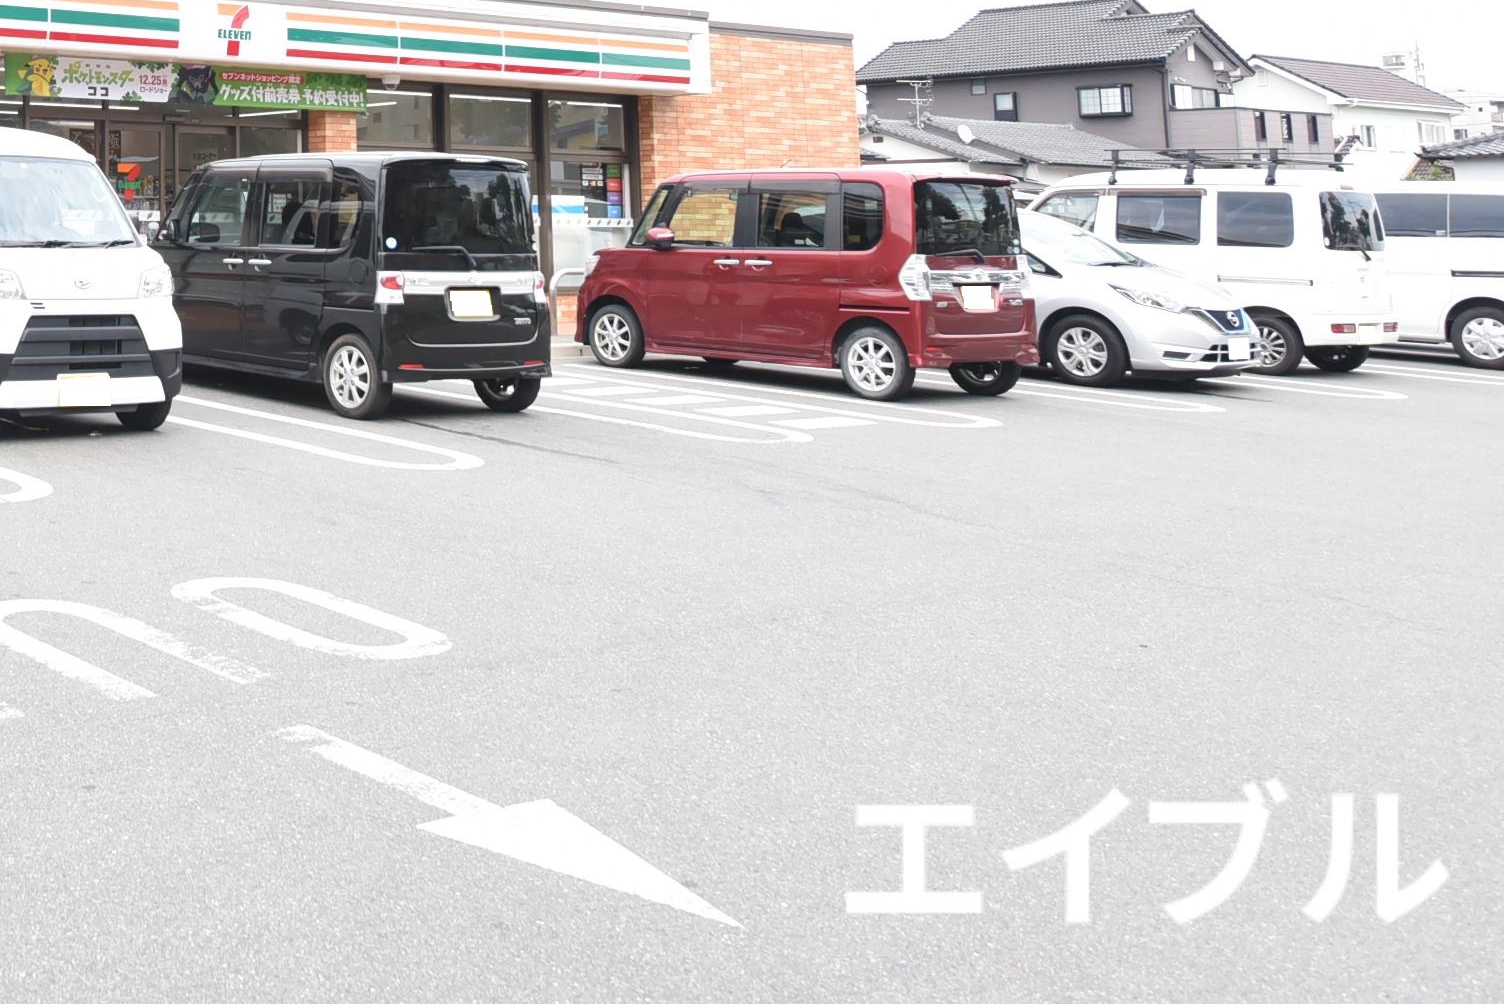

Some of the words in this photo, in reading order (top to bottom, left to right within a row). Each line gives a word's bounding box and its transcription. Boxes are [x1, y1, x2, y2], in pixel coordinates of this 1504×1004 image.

[61, 61, 134, 88] ポケットモンスター
[138, 74, 162, 86] 12.25
[87, 86, 109, 97] ココ
[139, 86, 168, 94] ロードショー
[219, 83, 301, 105] グッズ付前売券
